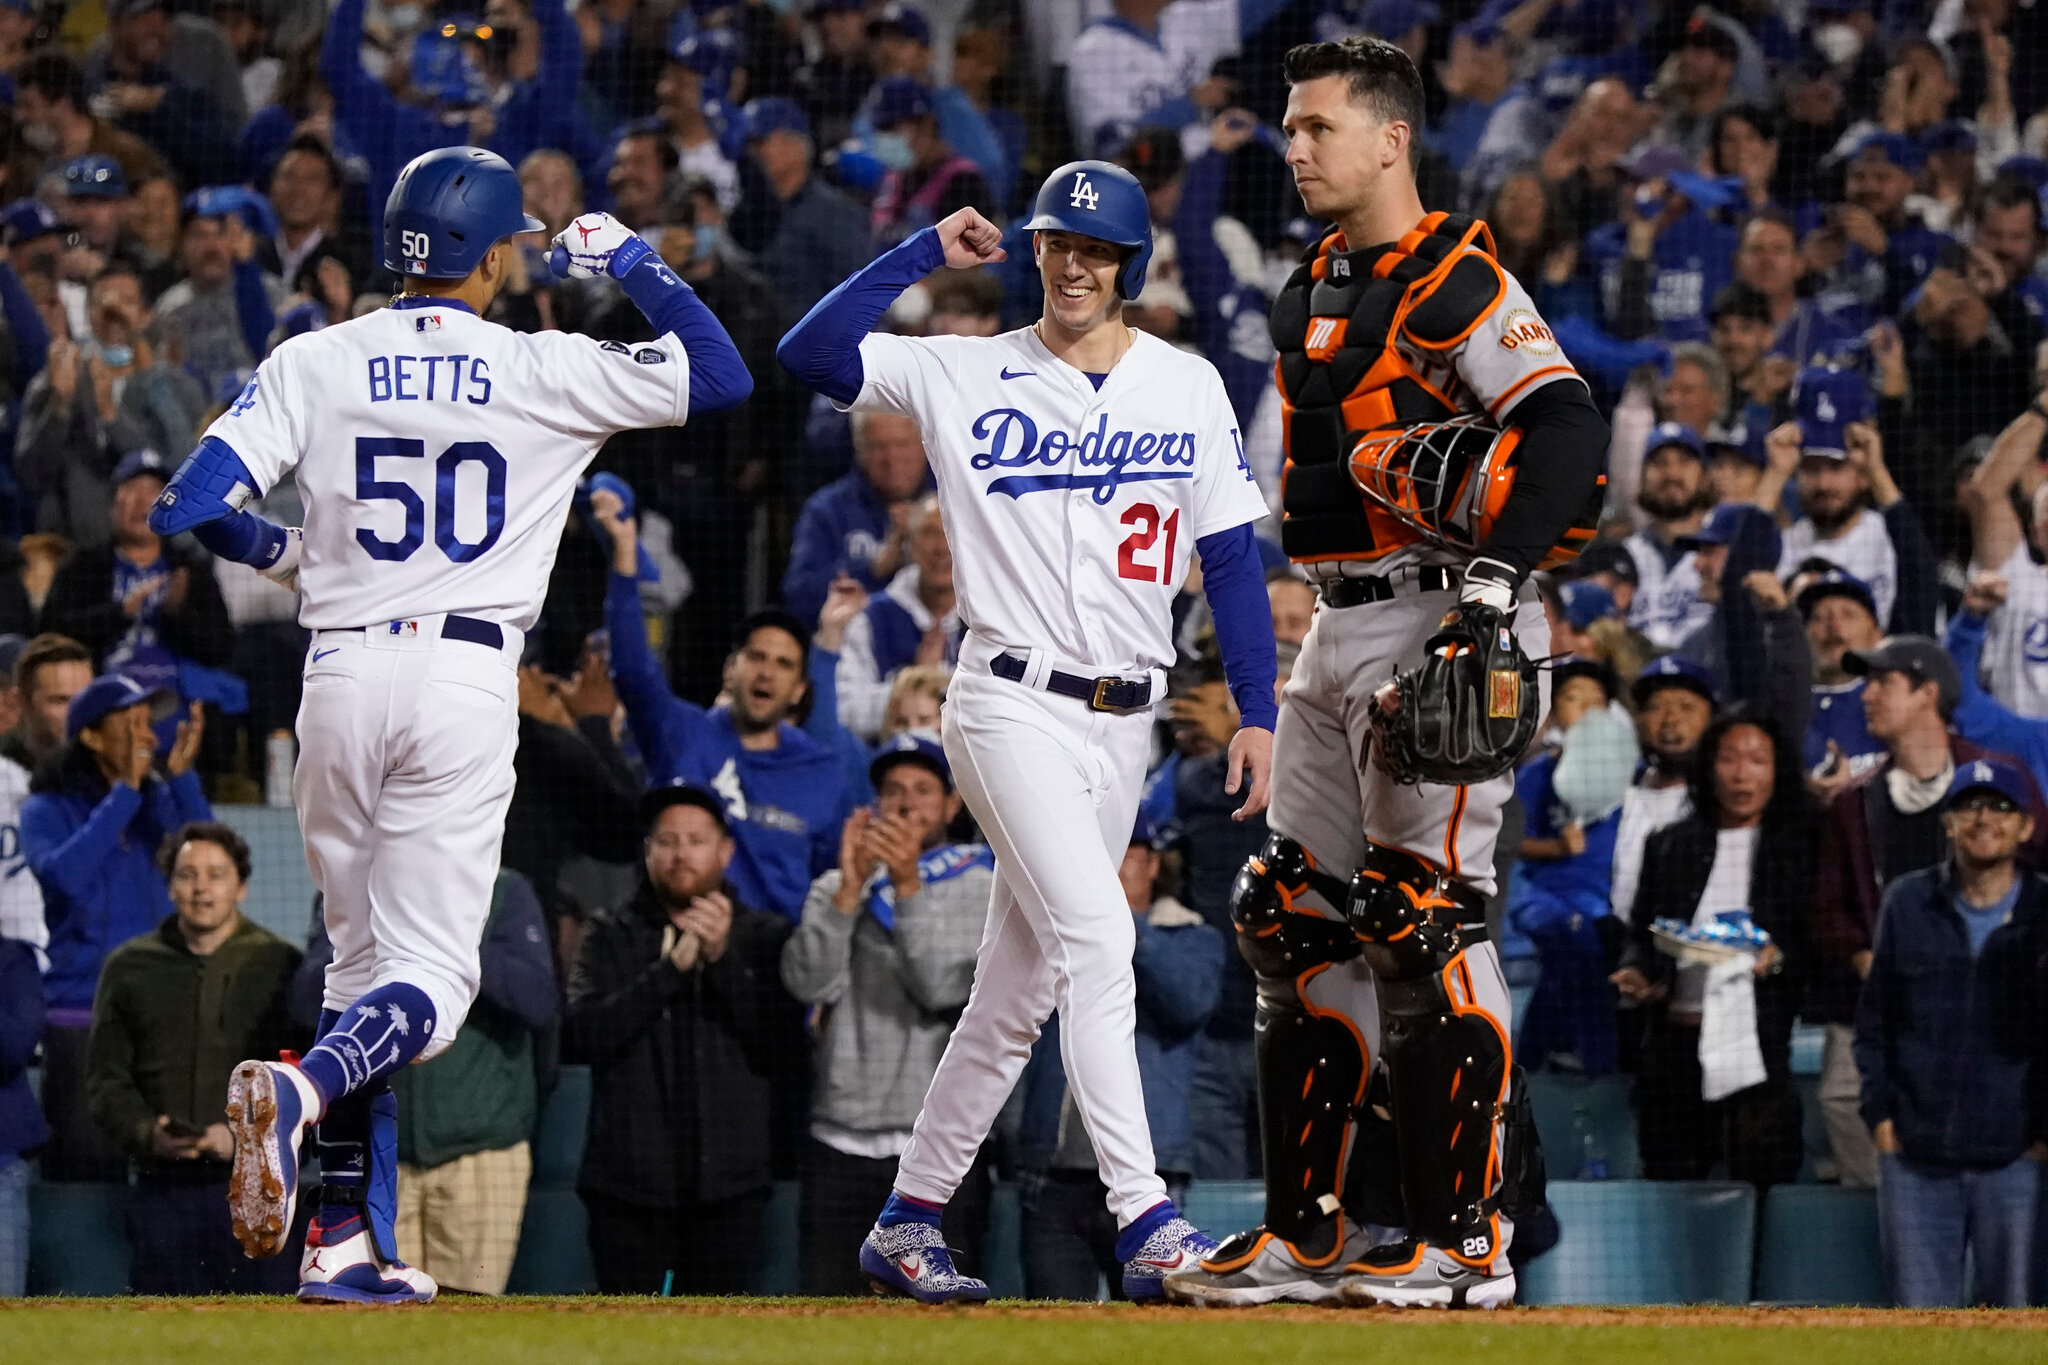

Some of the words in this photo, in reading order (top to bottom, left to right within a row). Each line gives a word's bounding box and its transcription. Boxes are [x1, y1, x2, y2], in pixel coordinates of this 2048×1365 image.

[1070, 172, 1099, 210] LA
[402, 230, 429, 259] 50
[1499, 320, 1556, 351] GIANT
[368, 355, 492, 405] BETTS
[970, 408, 1195, 505] Dodgers
[355, 436, 508, 563] 50
[1117, 502, 1180, 586] 21
[1463, 1236, 1489, 1257] 28
